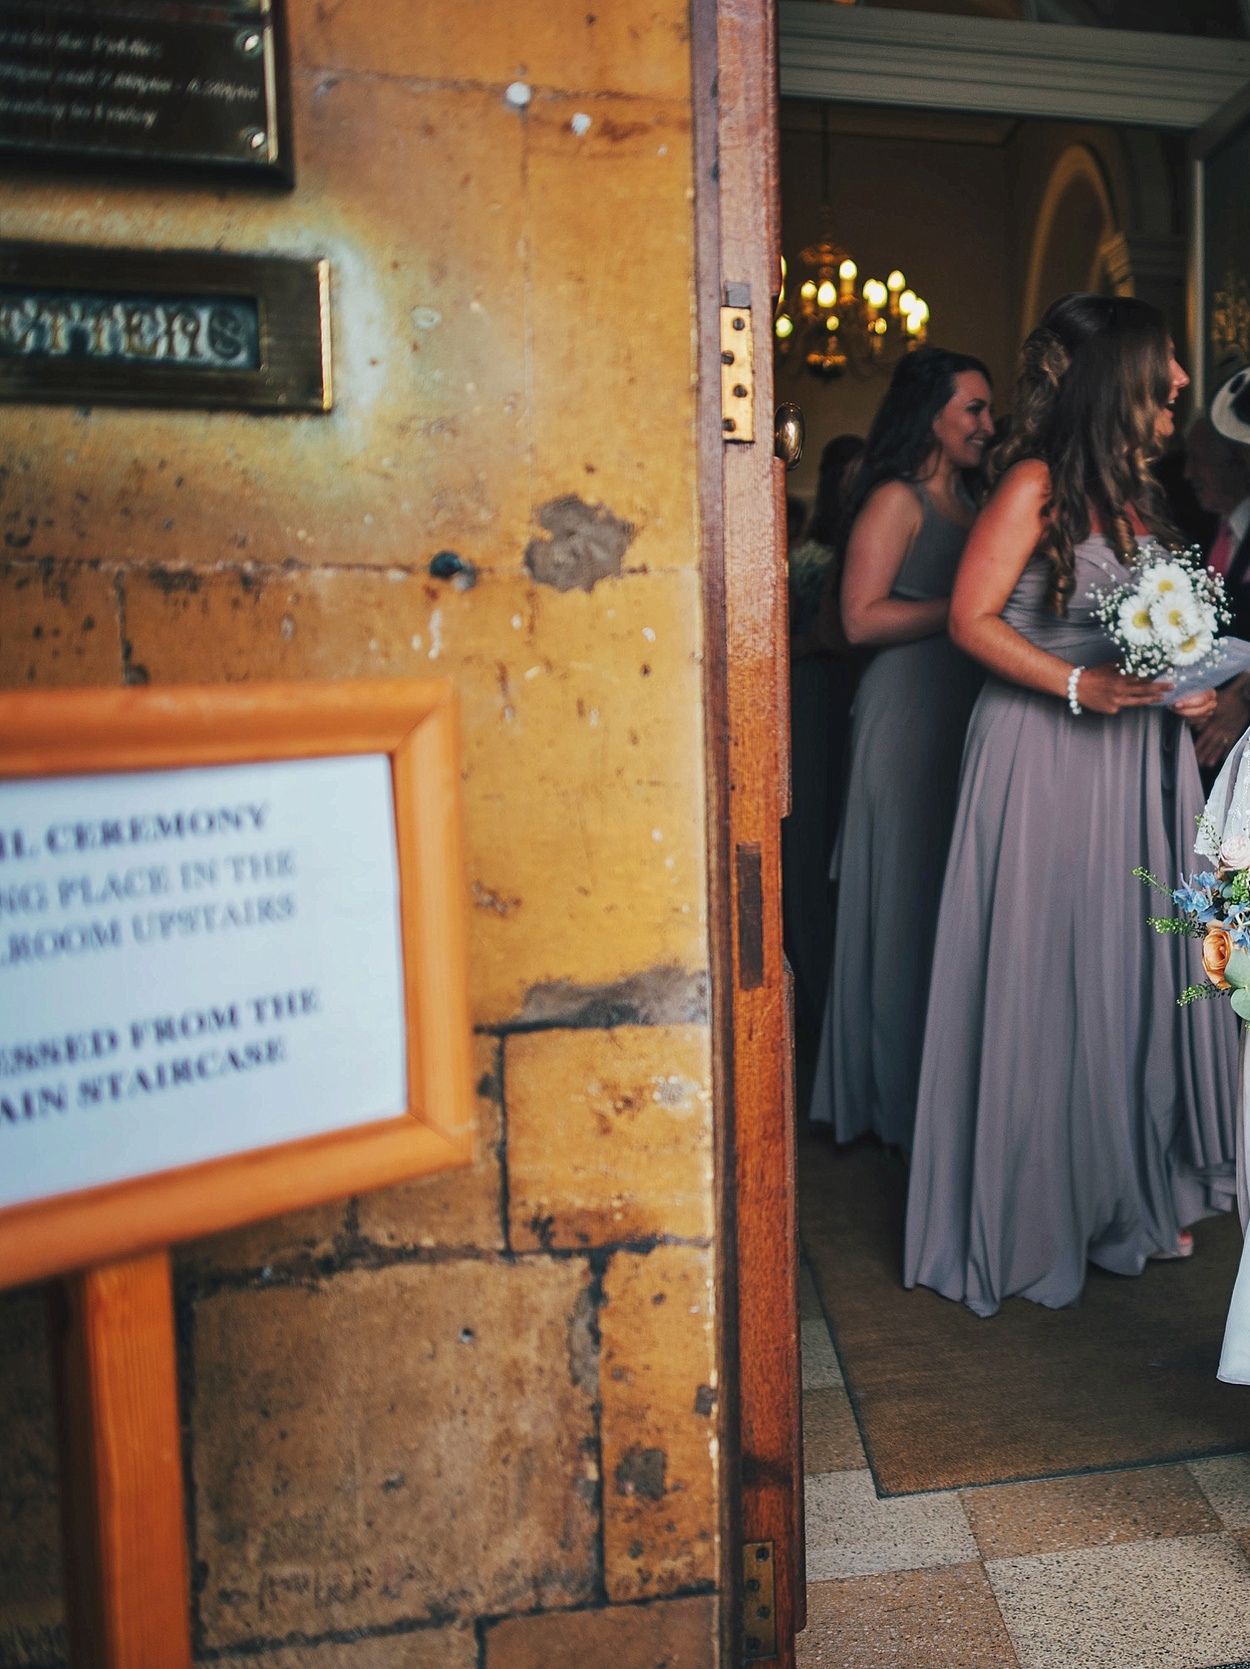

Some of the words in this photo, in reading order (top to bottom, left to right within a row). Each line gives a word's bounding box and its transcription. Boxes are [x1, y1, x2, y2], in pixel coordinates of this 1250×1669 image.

[45, 801, 268, 852] CEREMONY
[57, 865, 170, 908] PLACE
[179, 856, 217, 891] IN
[227, 849, 296, 884] THE
[9, 916, 121, 963] ROOM
[131, 892, 296, 944] UPSTAIRS
[130, 1003, 239, 1049] FROM
[248, 986, 320, 1025] THE
[77, 1034, 287, 1109] STAIRCASE
